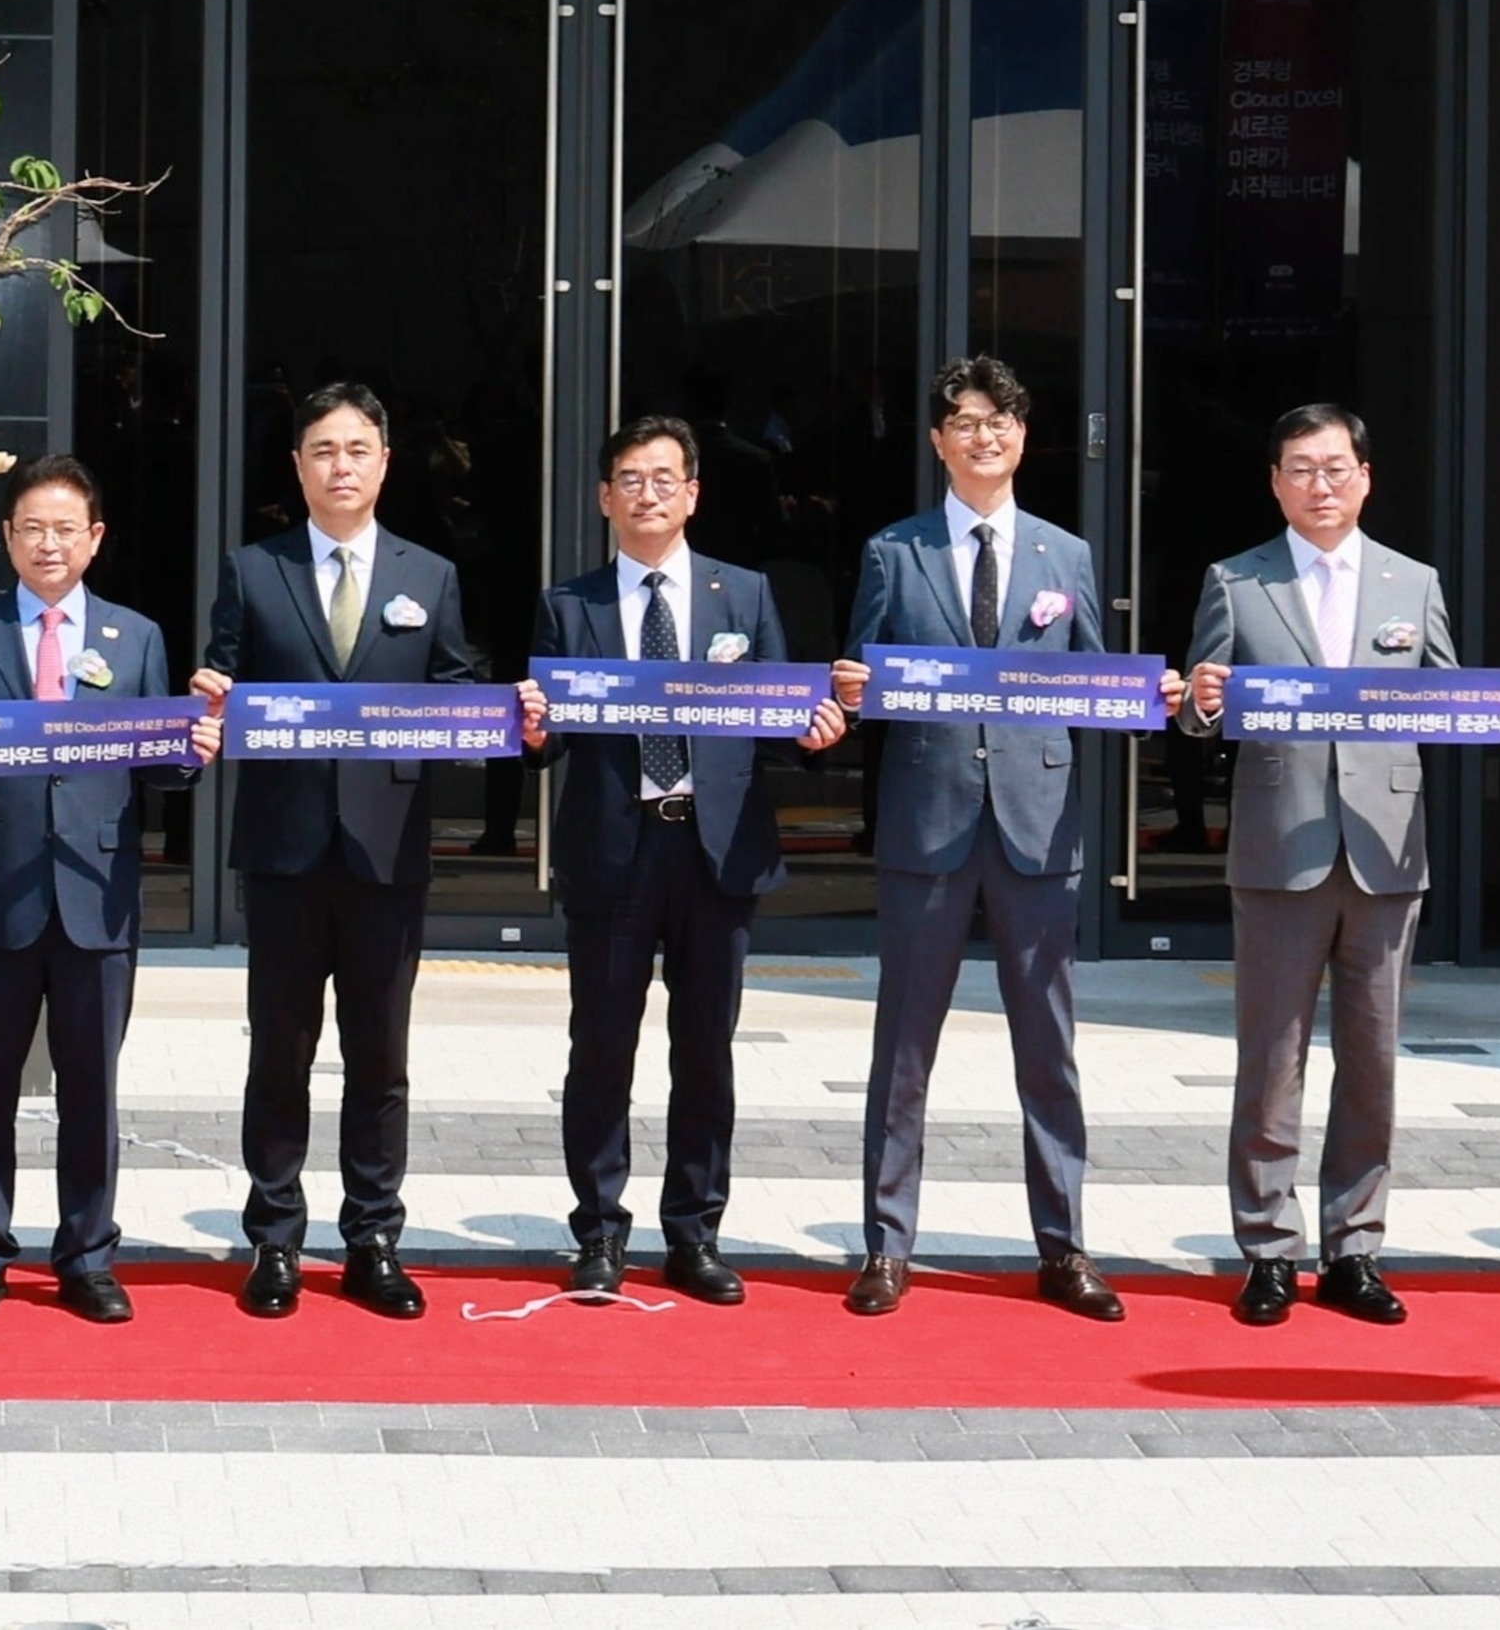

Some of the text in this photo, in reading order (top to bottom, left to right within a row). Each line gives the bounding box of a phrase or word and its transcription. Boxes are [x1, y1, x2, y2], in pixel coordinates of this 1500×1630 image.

[548, 703, 810, 727] 경북형 클라우드 데이터센터 준공식
[882, 690, 1145, 718] 경북형 클라우드 데이터센터 준공식
[1242, 711, 1291, 731] 경북형
[1296, 712, 1364, 730] 클라우드
[1368, 713, 1451, 732] 데이터센터
[245, 728, 505, 748] 경북형 클라우드 데이터센터 준공식
[53, 742, 133, 763] 데이터센터
[138, 738, 186, 757] 준공식
